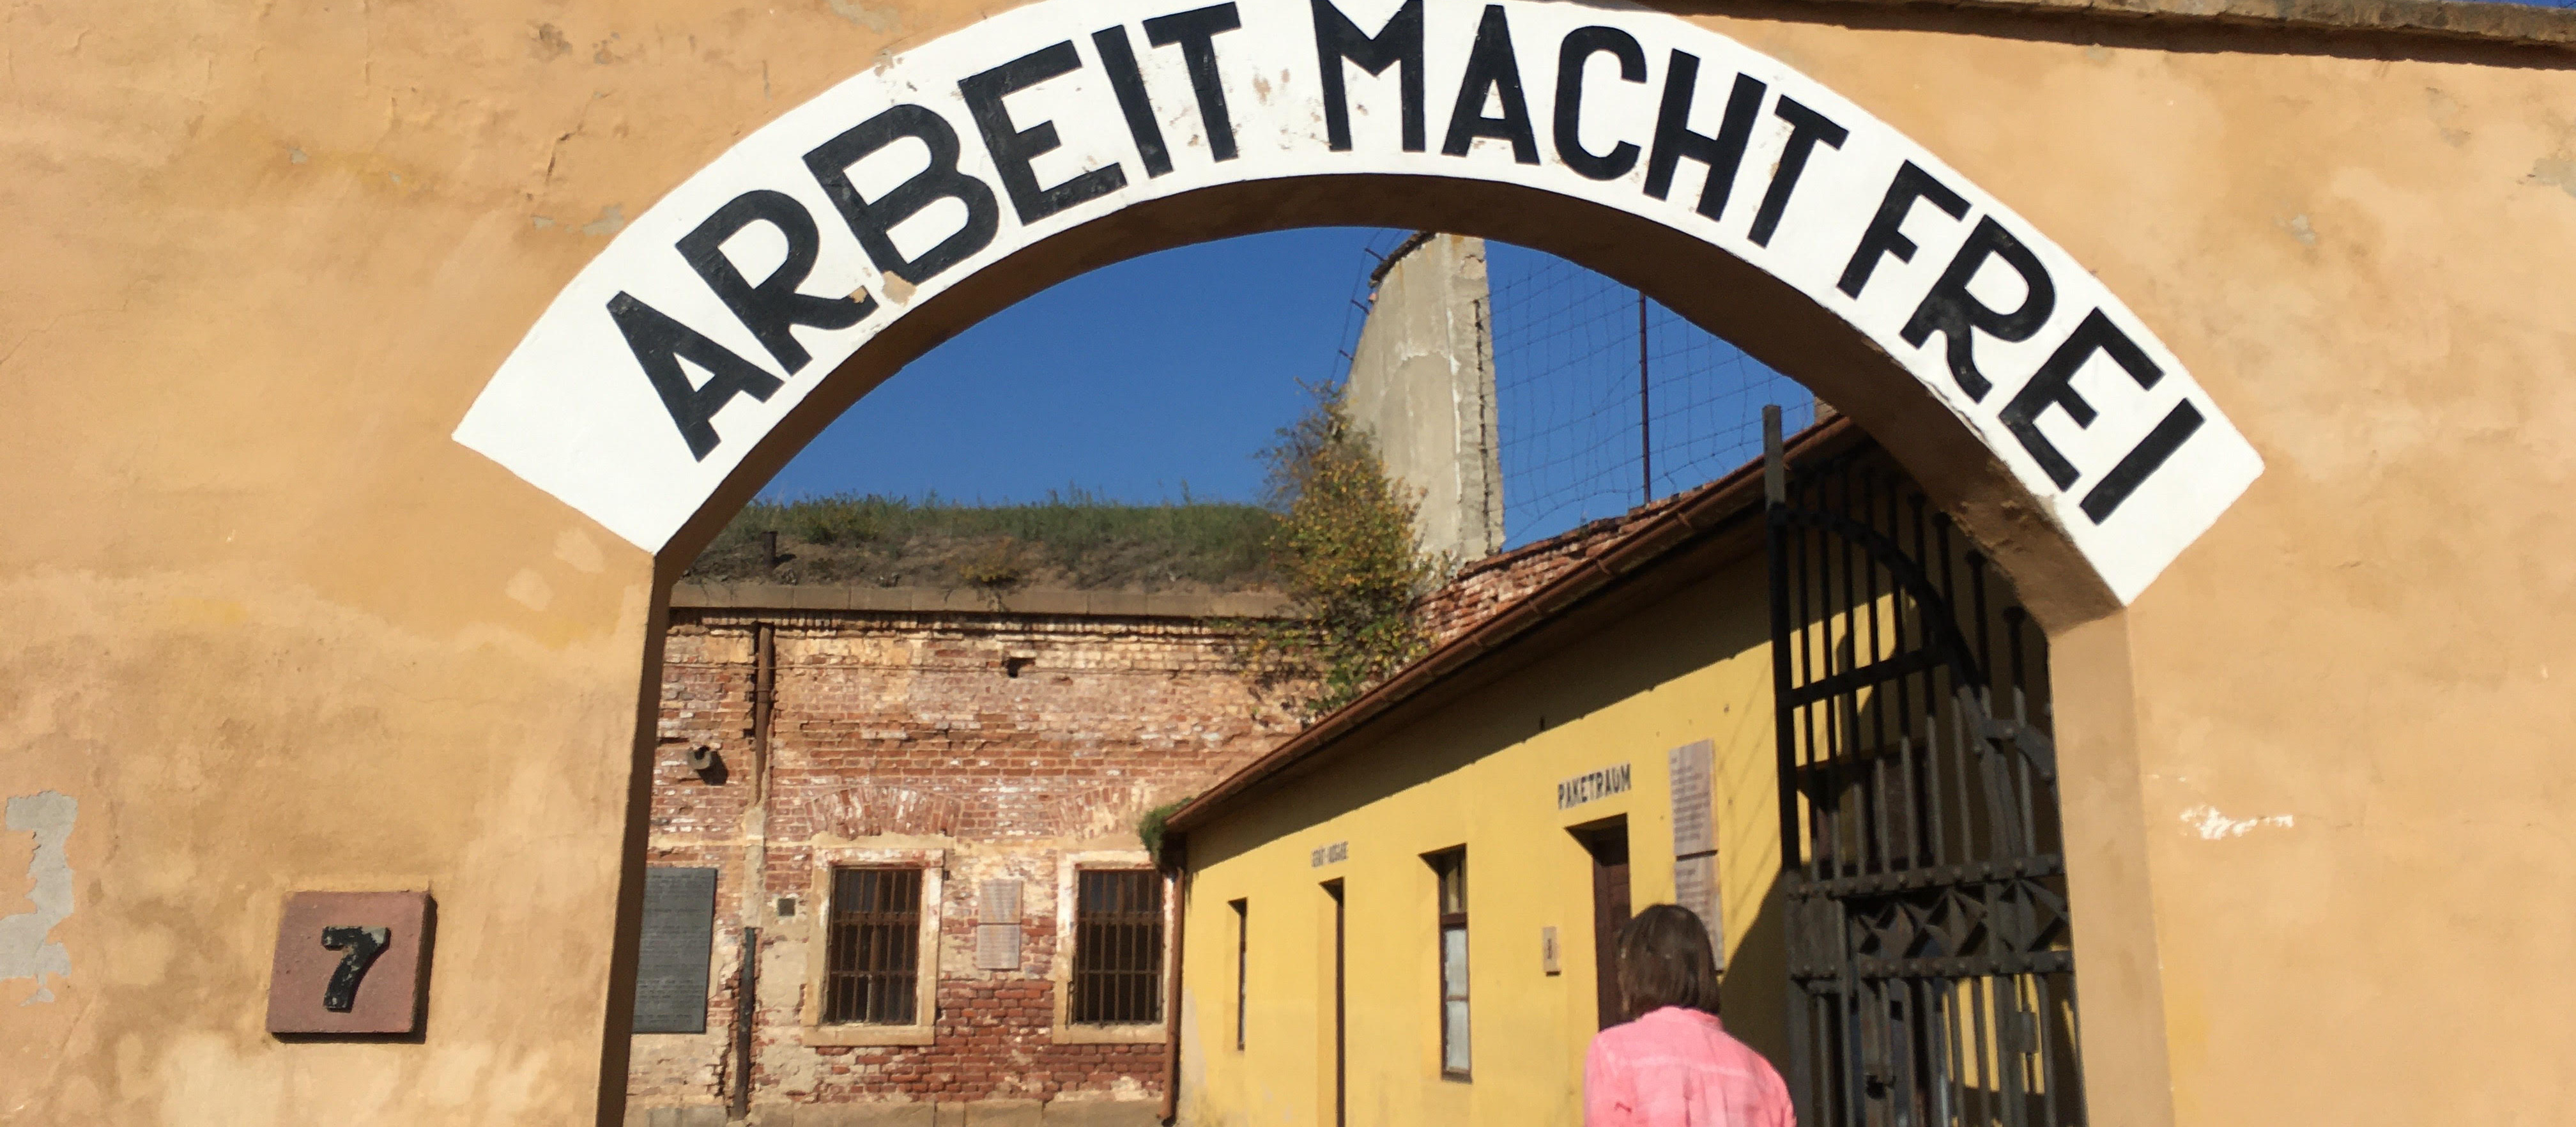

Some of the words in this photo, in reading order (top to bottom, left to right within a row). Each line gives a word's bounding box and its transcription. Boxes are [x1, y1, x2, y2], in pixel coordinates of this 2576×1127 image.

[606, 1, 1241, 463] ARBEIT
[1310, 0, 1850, 249] MACHT
[1836, 159, 2206, 525] FREI
[1558, 763, 1631, 810] PAKETRAUM
[321, 926, 391, 1013] 7
